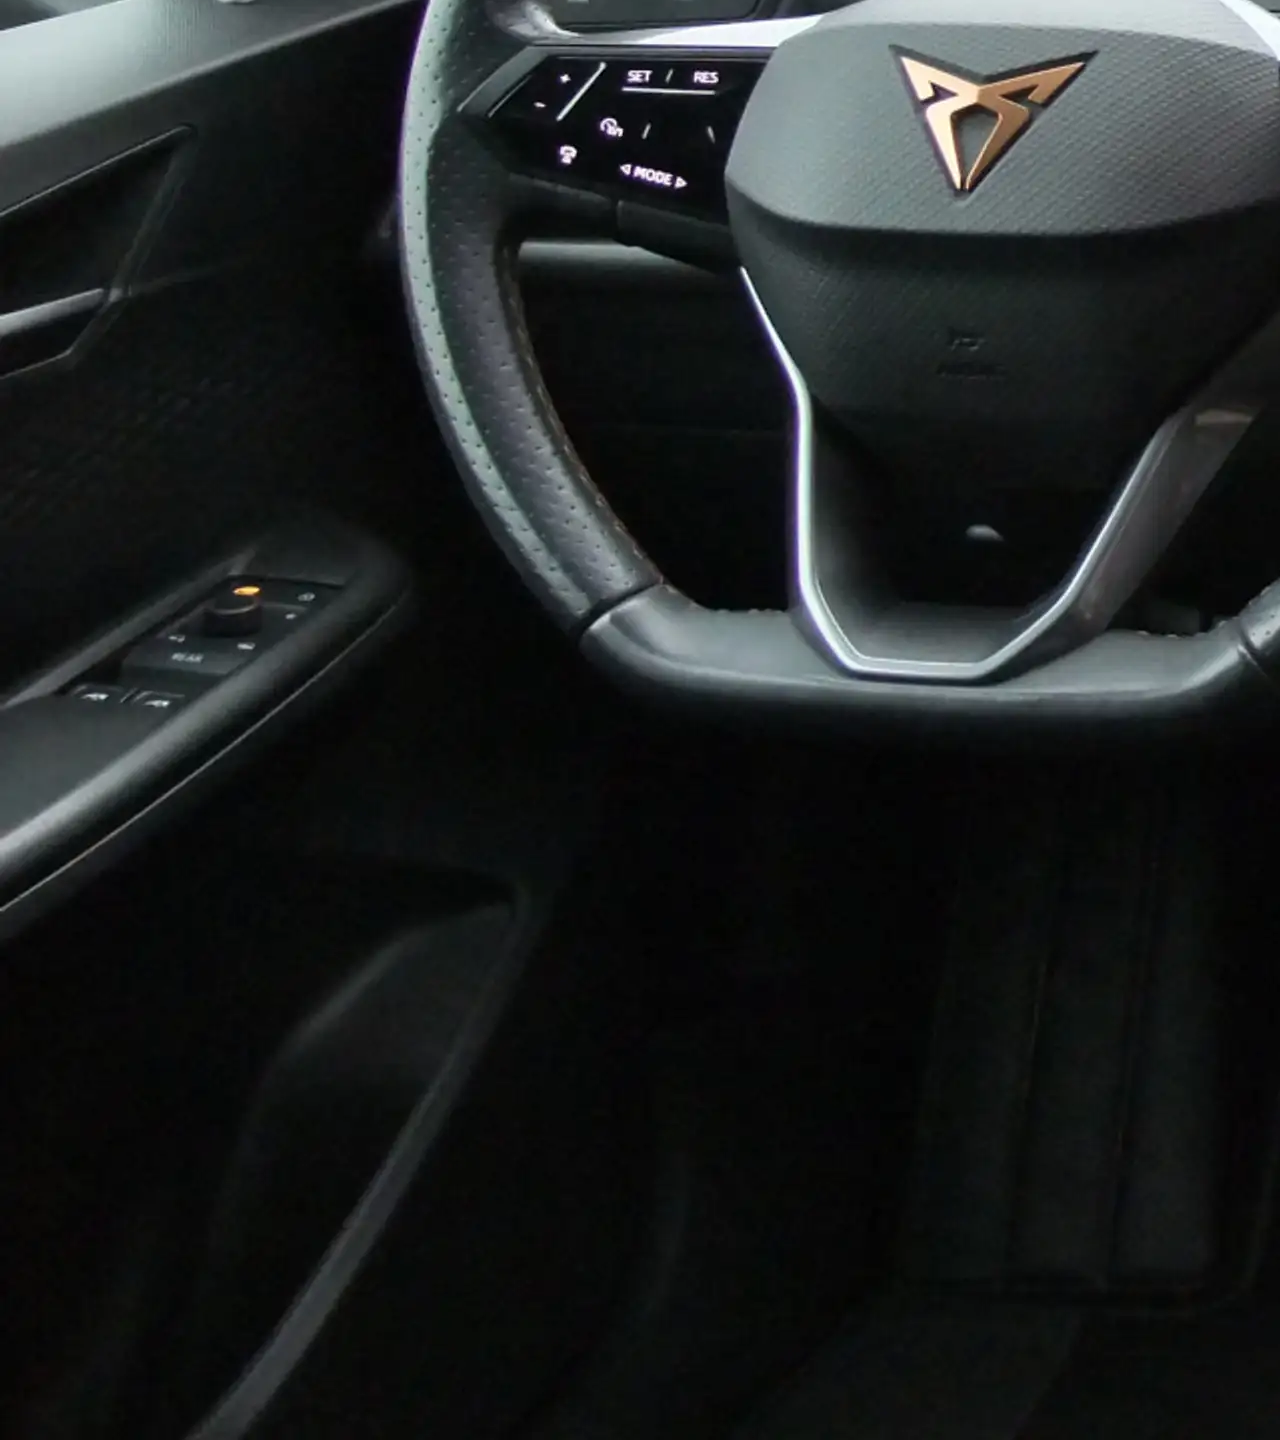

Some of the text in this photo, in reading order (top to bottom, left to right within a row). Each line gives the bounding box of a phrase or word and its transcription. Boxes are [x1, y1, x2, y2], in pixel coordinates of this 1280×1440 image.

[627, 69, 653, 83] SET
[693, 70, 719, 84] RES
[633, 166, 673, 186] MODE
